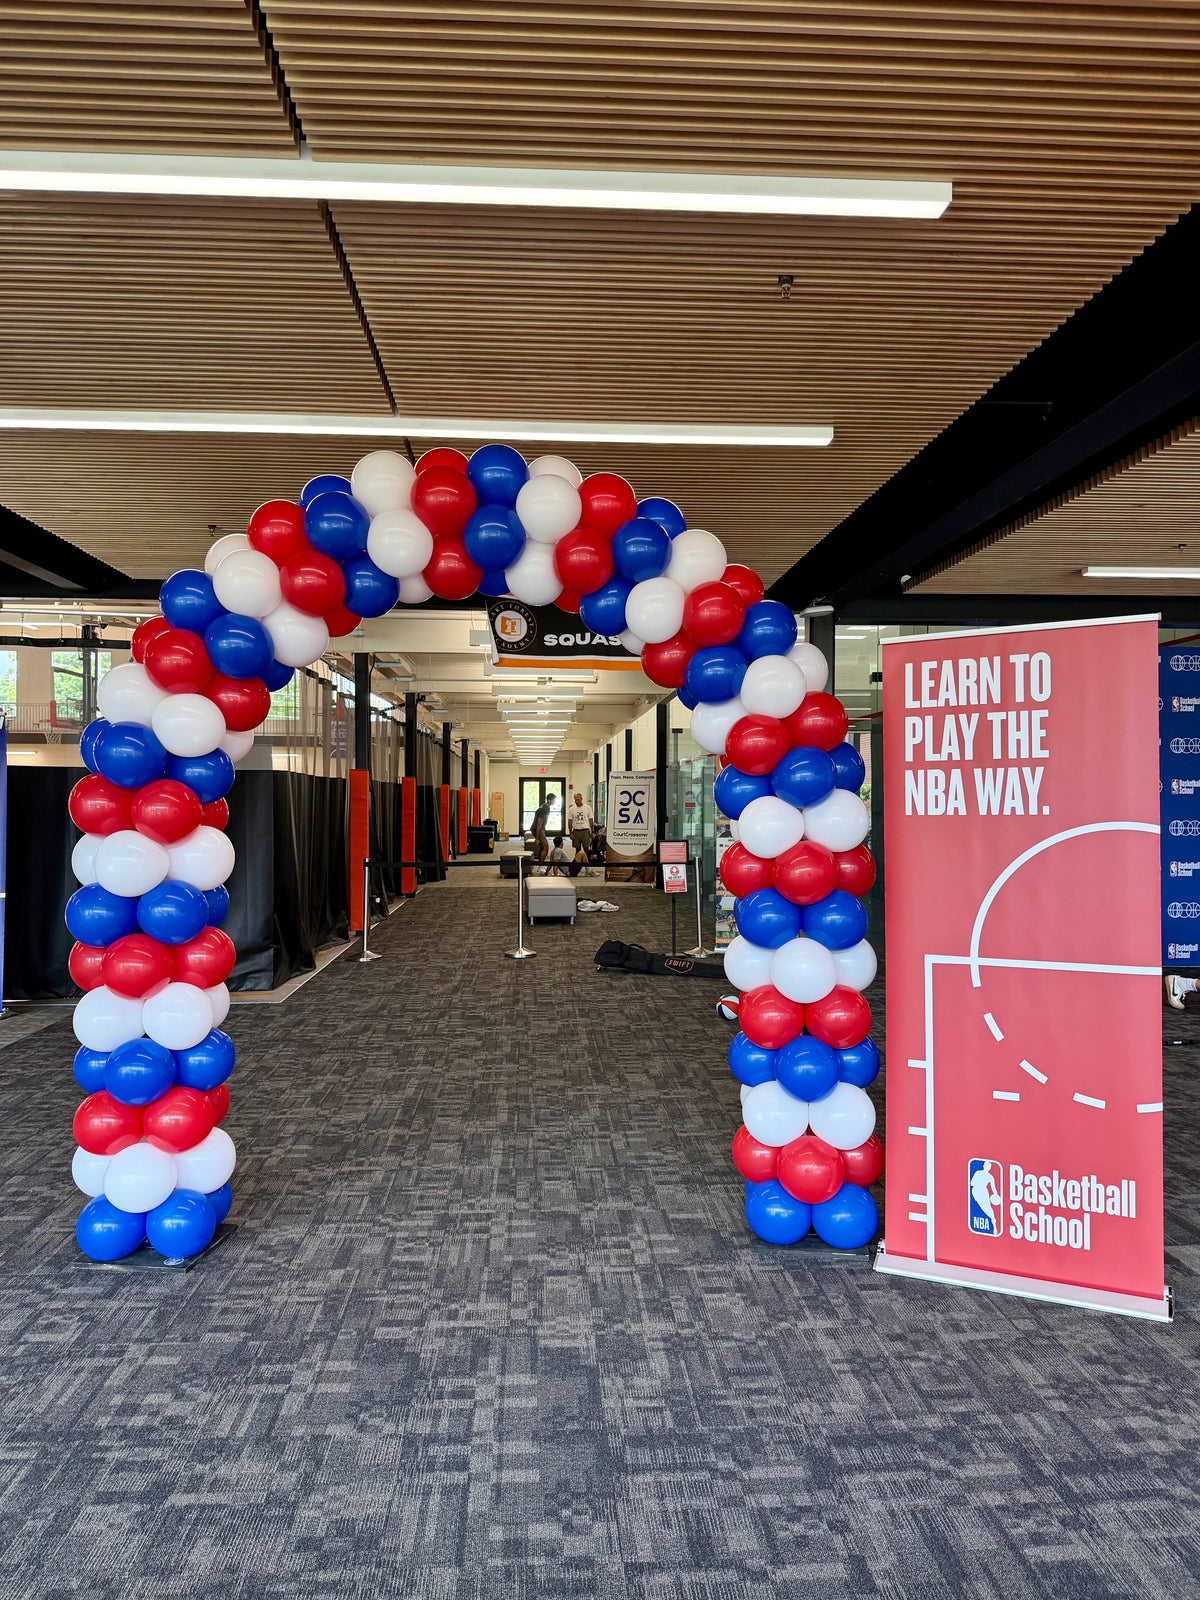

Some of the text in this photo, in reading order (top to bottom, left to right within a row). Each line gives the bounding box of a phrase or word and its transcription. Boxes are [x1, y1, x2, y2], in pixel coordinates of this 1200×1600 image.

[543, 632, 622, 646] SQUAS
[904, 651, 1052, 709] LEARN TO
[904, 709, 1050, 762] PLAY THE
[904, 766, 1050, 816] NBA WAY.
[668, 959, 690, 969] SWIFT
[1009, 1164, 1136, 1219] Basketball
[973, 1216, 990, 1230] NBA
[1009, 1202, 1091, 1250] School
